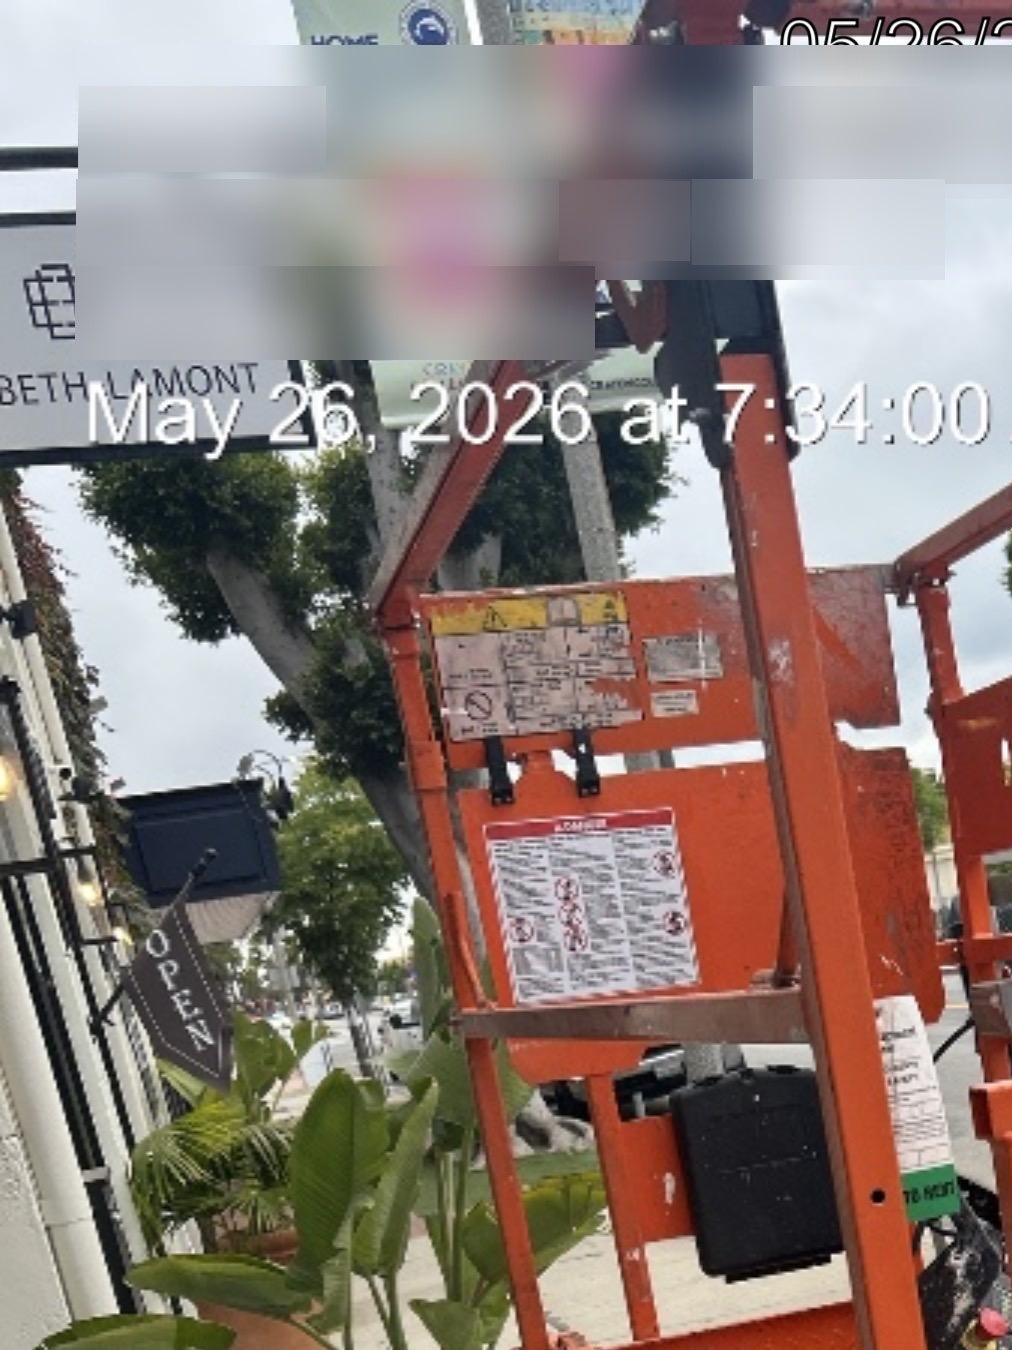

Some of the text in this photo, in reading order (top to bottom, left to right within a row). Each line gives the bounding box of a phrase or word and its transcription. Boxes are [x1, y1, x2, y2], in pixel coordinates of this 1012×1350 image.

[0, 363, 259, 406] BETH LAMONT
[145, 928, 216, 1053] OPEN
